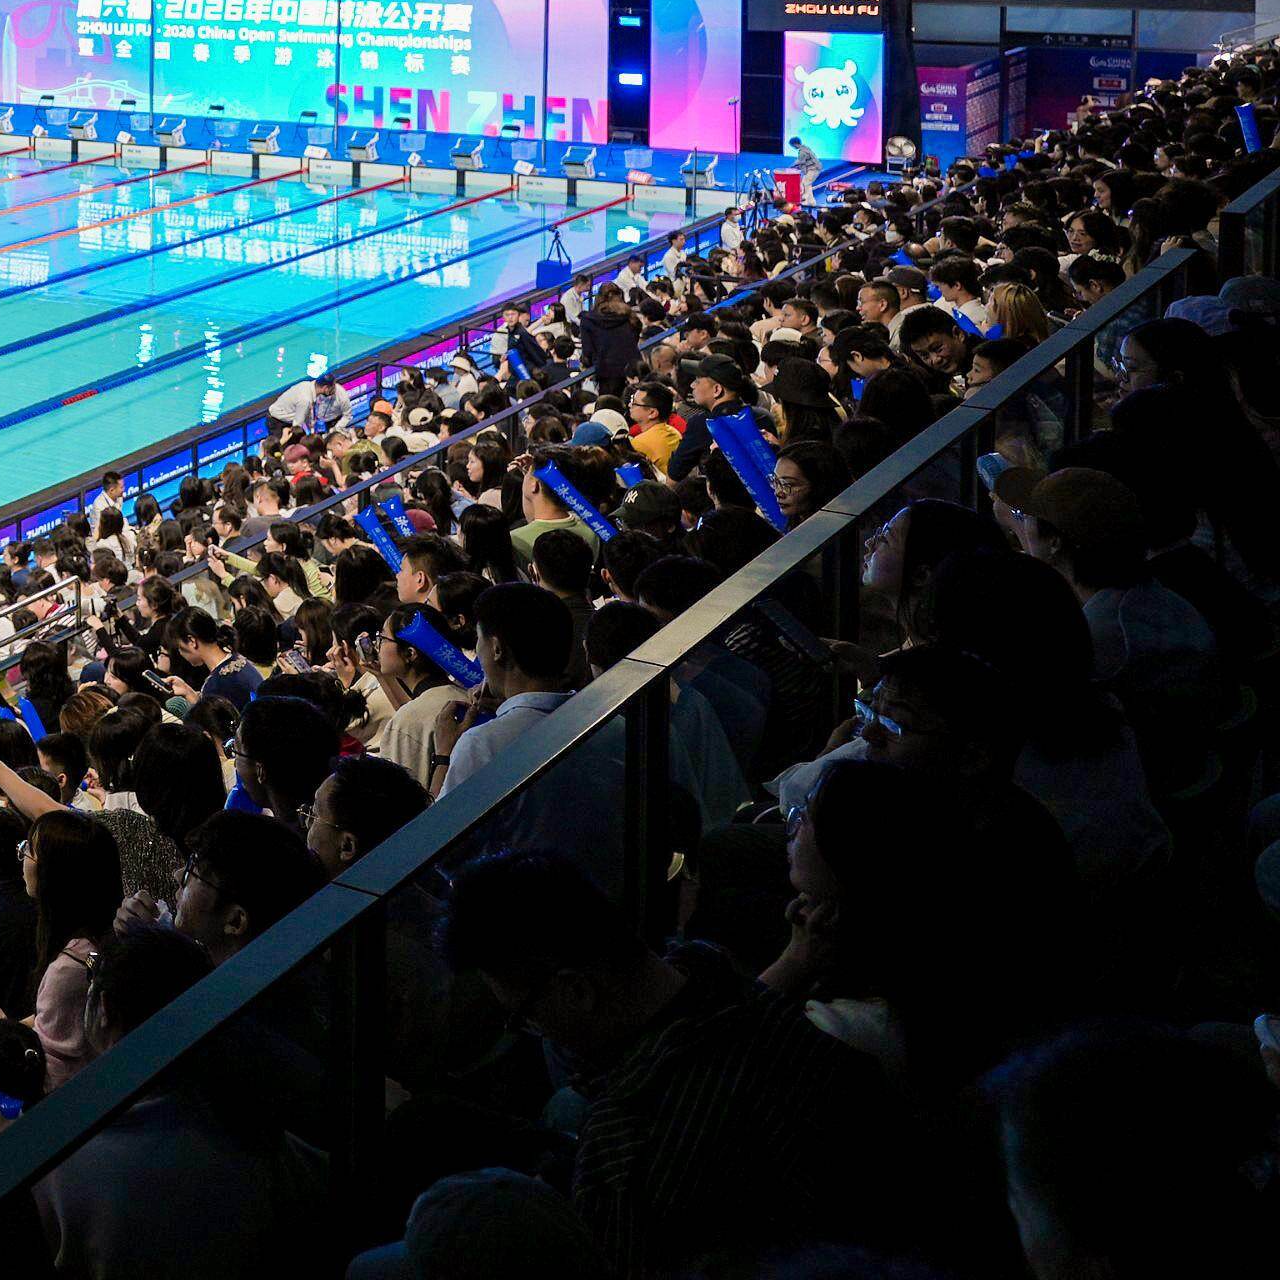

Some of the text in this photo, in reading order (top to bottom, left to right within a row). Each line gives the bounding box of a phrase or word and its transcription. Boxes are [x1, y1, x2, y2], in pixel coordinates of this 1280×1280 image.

[785, 3, 879, 16] ZHOU LIU FU
[76, 21, 113, 35] ZHOU
[162, 24, 195, 39] 2026
[197, 25, 236, 41] China
[238, 28, 276, 44] Open
[278, 29, 354, 49] Swimming
[356, 31, 472, 51] Championships
[325, 82, 609, 146] SHEN ZHEN
[624, 489, 639, 504] NY
